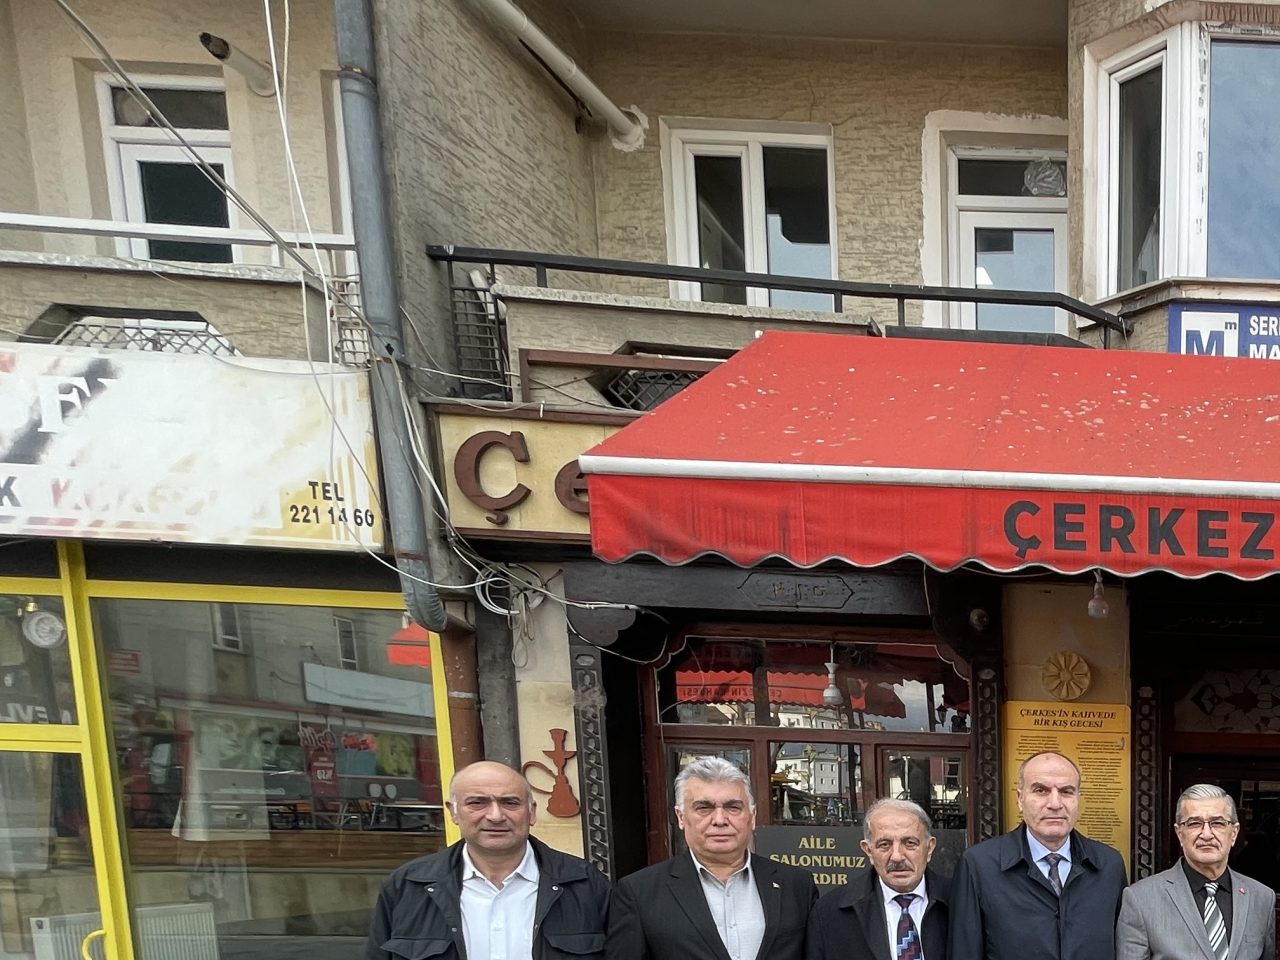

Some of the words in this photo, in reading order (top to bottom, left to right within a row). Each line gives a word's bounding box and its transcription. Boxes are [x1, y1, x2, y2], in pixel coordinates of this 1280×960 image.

[308, 480, 345, 502] TEL
[289, 504, 320, 524] 221
[1071, 710, 1117, 720] KAHVEDE
[1034, 718, 1050, 727] BİR
[1052, 719, 1068, 728] KIŞ
[1069, 719, 1104, 729] GECESİ
[798, 834, 837, 850] AİLE
[769, 853, 866, 868] SALONUMUZ
[812, 872, 848, 885] RDIR
